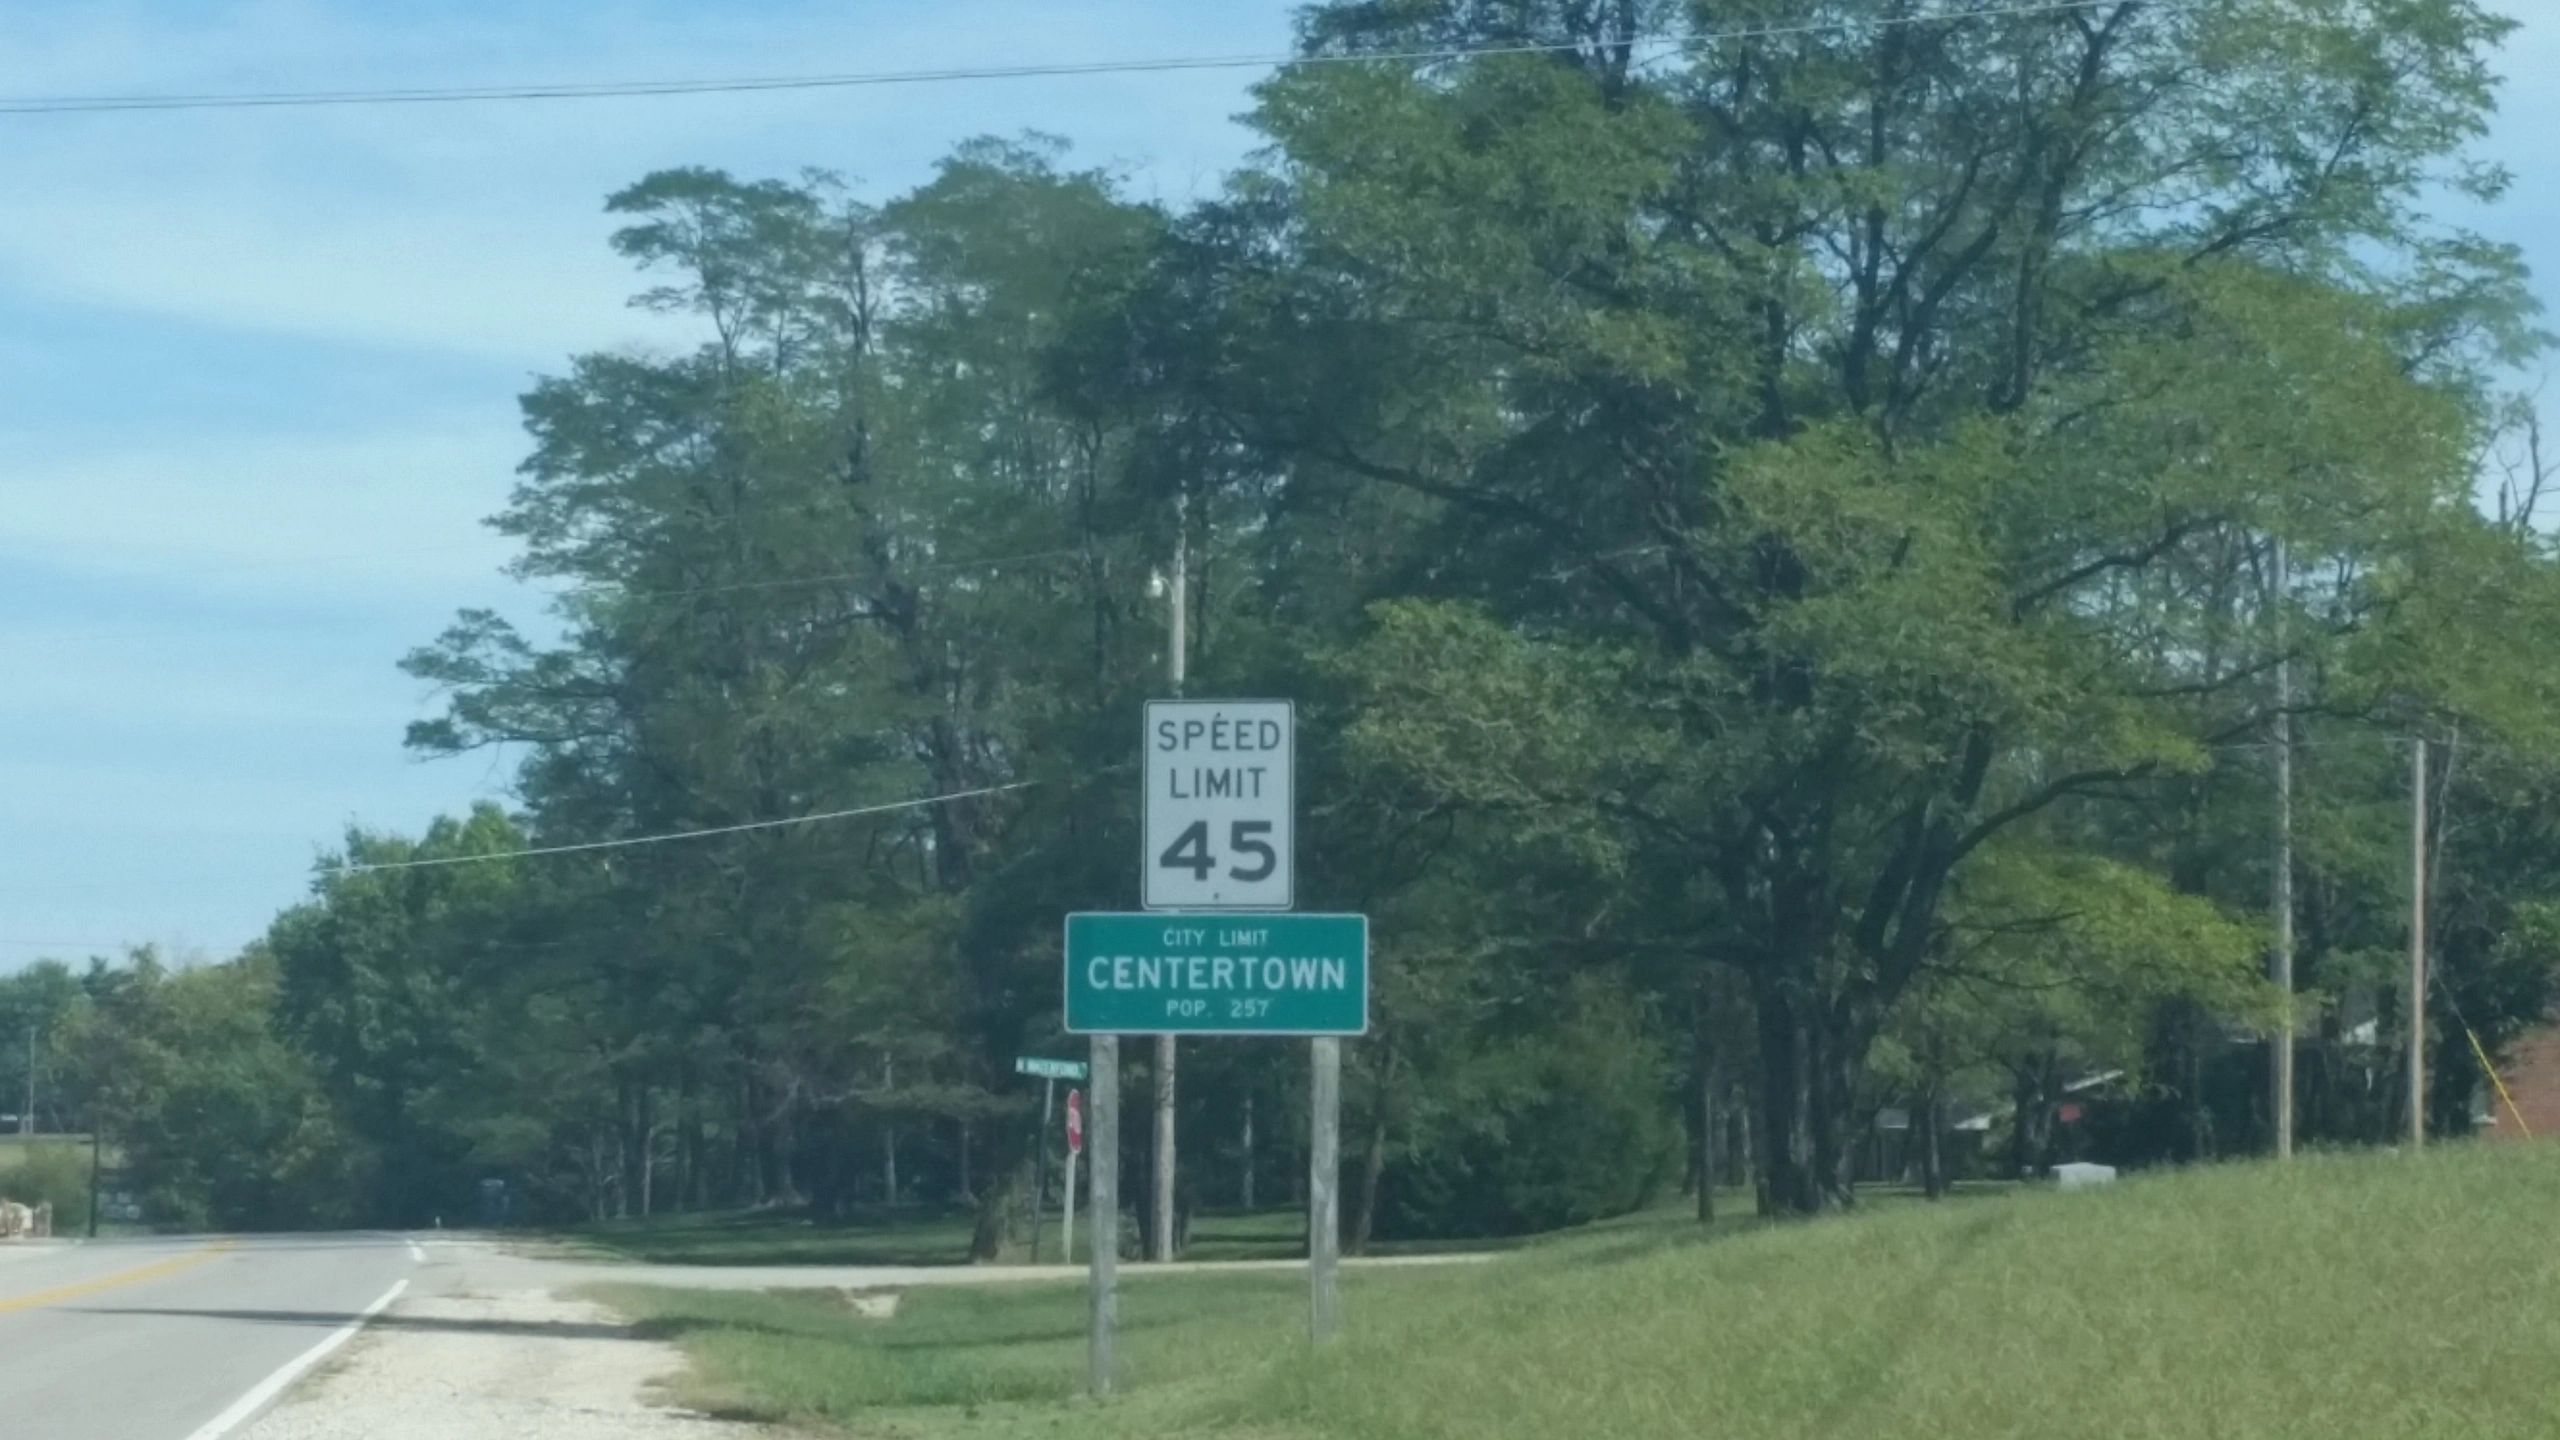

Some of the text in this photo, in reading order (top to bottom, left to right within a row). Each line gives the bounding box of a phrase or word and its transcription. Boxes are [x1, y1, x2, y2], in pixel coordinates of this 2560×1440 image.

[1158, 720, 1280, 751] SPEED
[1170, 768, 1266, 798] LIMIT
[1159, 820, 1277, 882] 45
[1163, 929, 1269, 947] CITY LIMIT
[1087, 956, 1345, 990] CENTERTOWN
[1166, 1000, 1270, 1018] POP. 257
